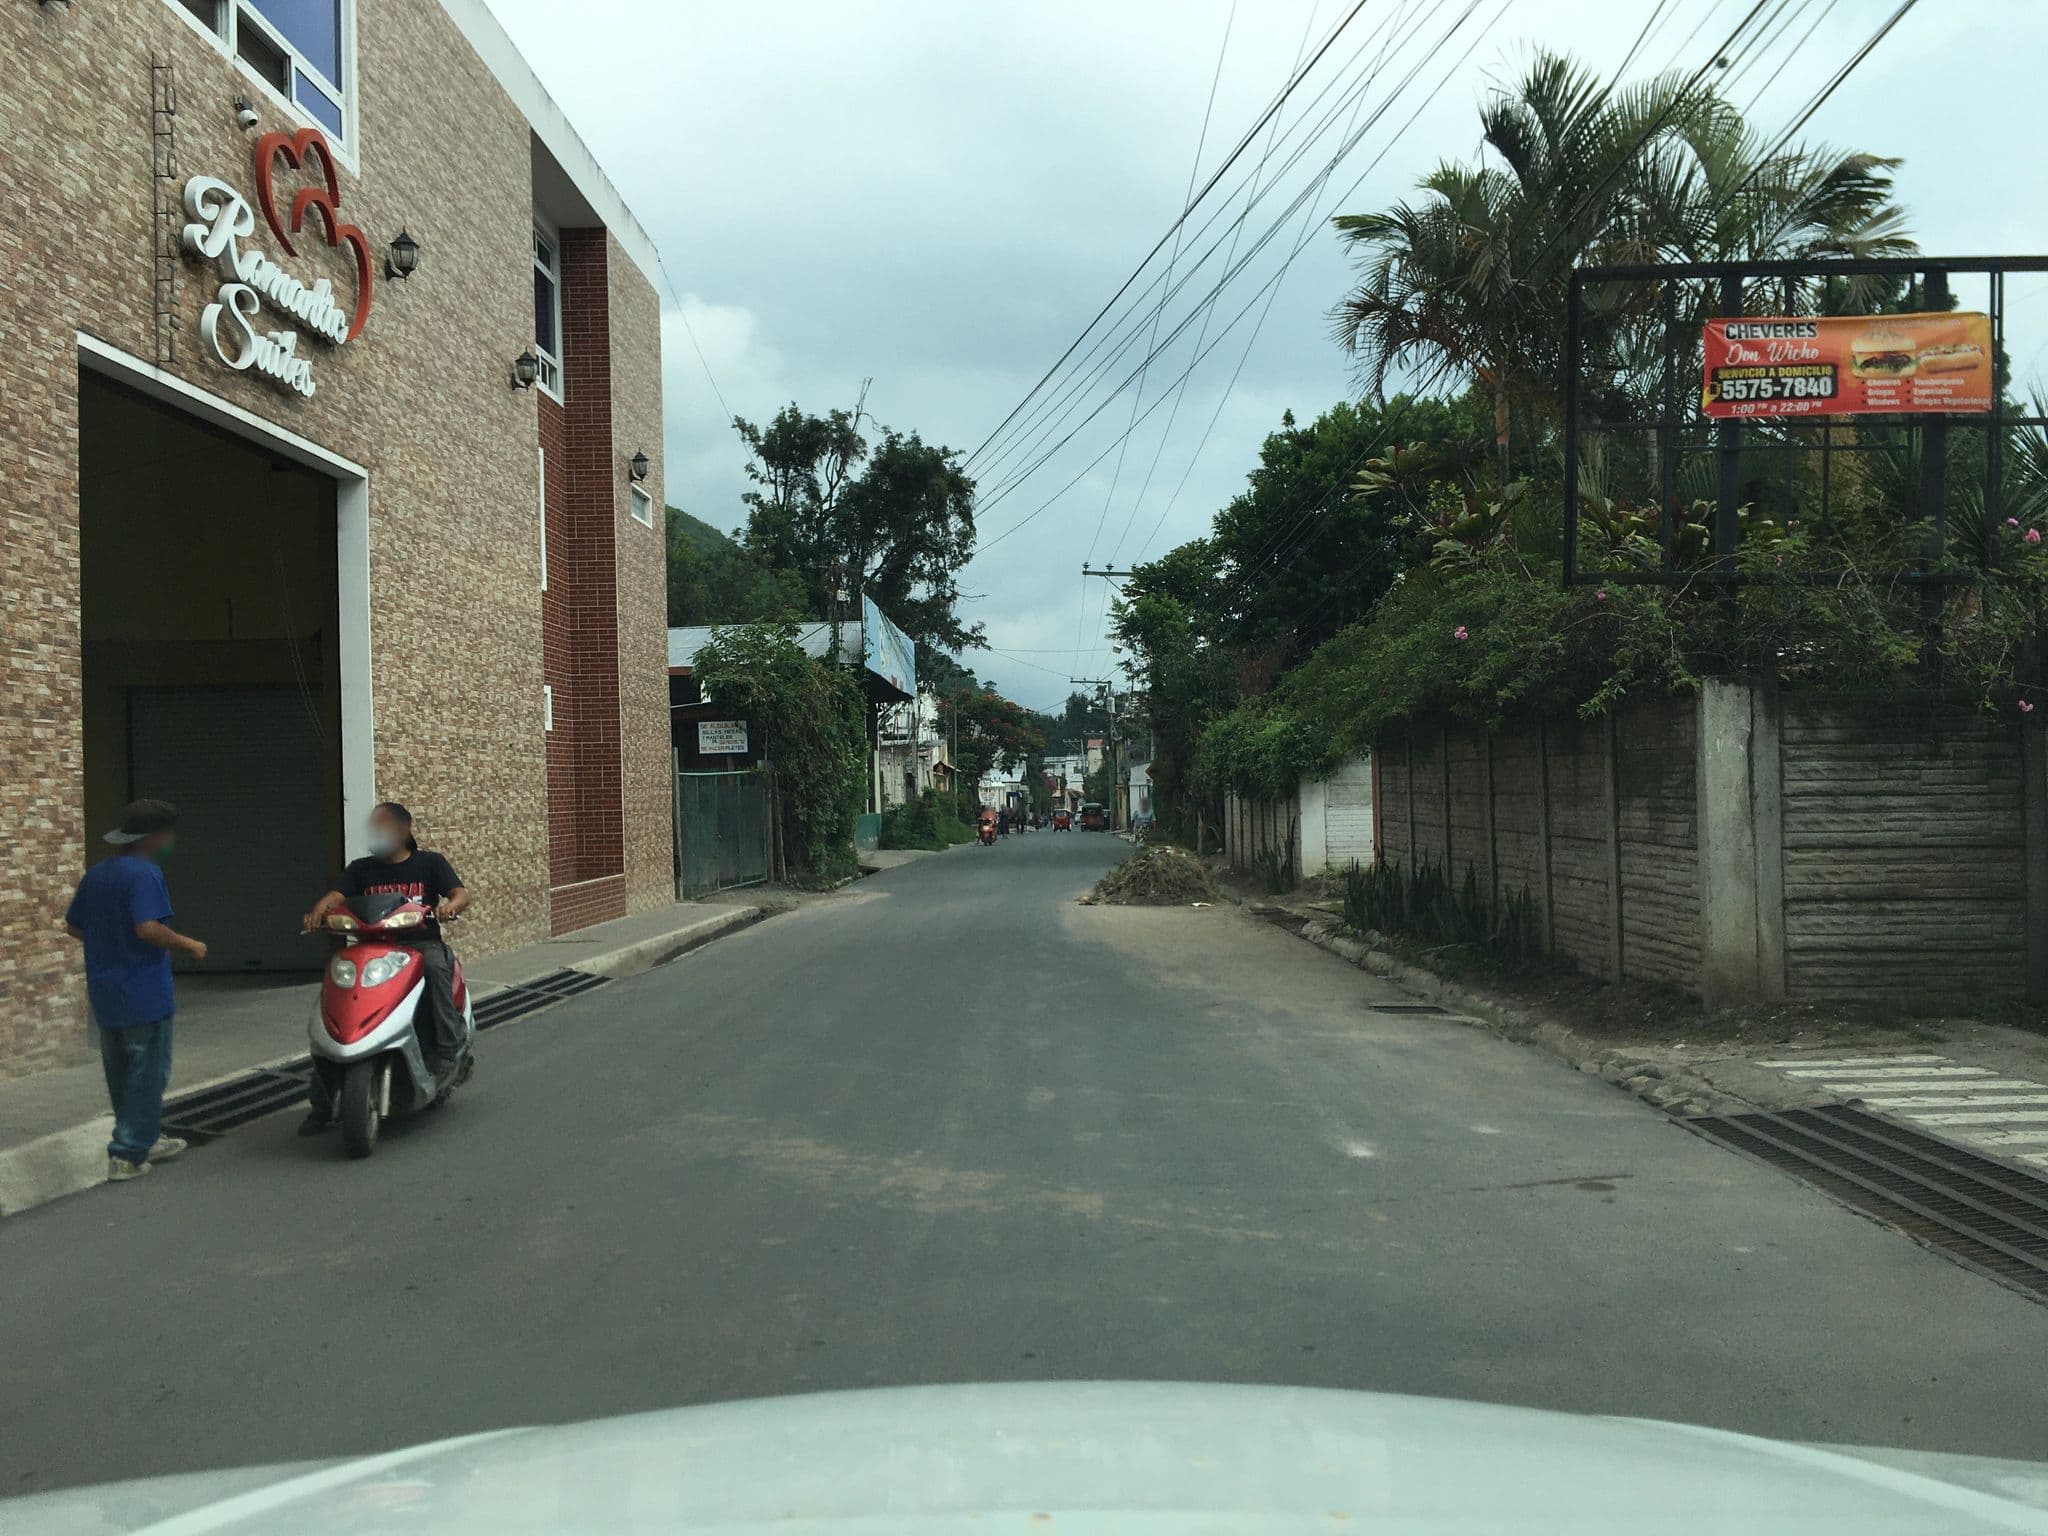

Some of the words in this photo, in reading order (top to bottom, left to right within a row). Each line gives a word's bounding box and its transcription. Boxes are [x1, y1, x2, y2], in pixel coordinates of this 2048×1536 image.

[200, 283, 316, 397] Suites
[1725, 322, 1818, 340] CHEVERES
[1726, 343, 1760, 365] Don
[1767, 341, 1820, 362] Wicho
[1718, 367, 1766, 379] SERVICIO
[1769, 367, 1776, 378] A
[1779, 365, 1833, 377] DOMICILIO
[1722, 377, 1832, 400] 5575-7840
